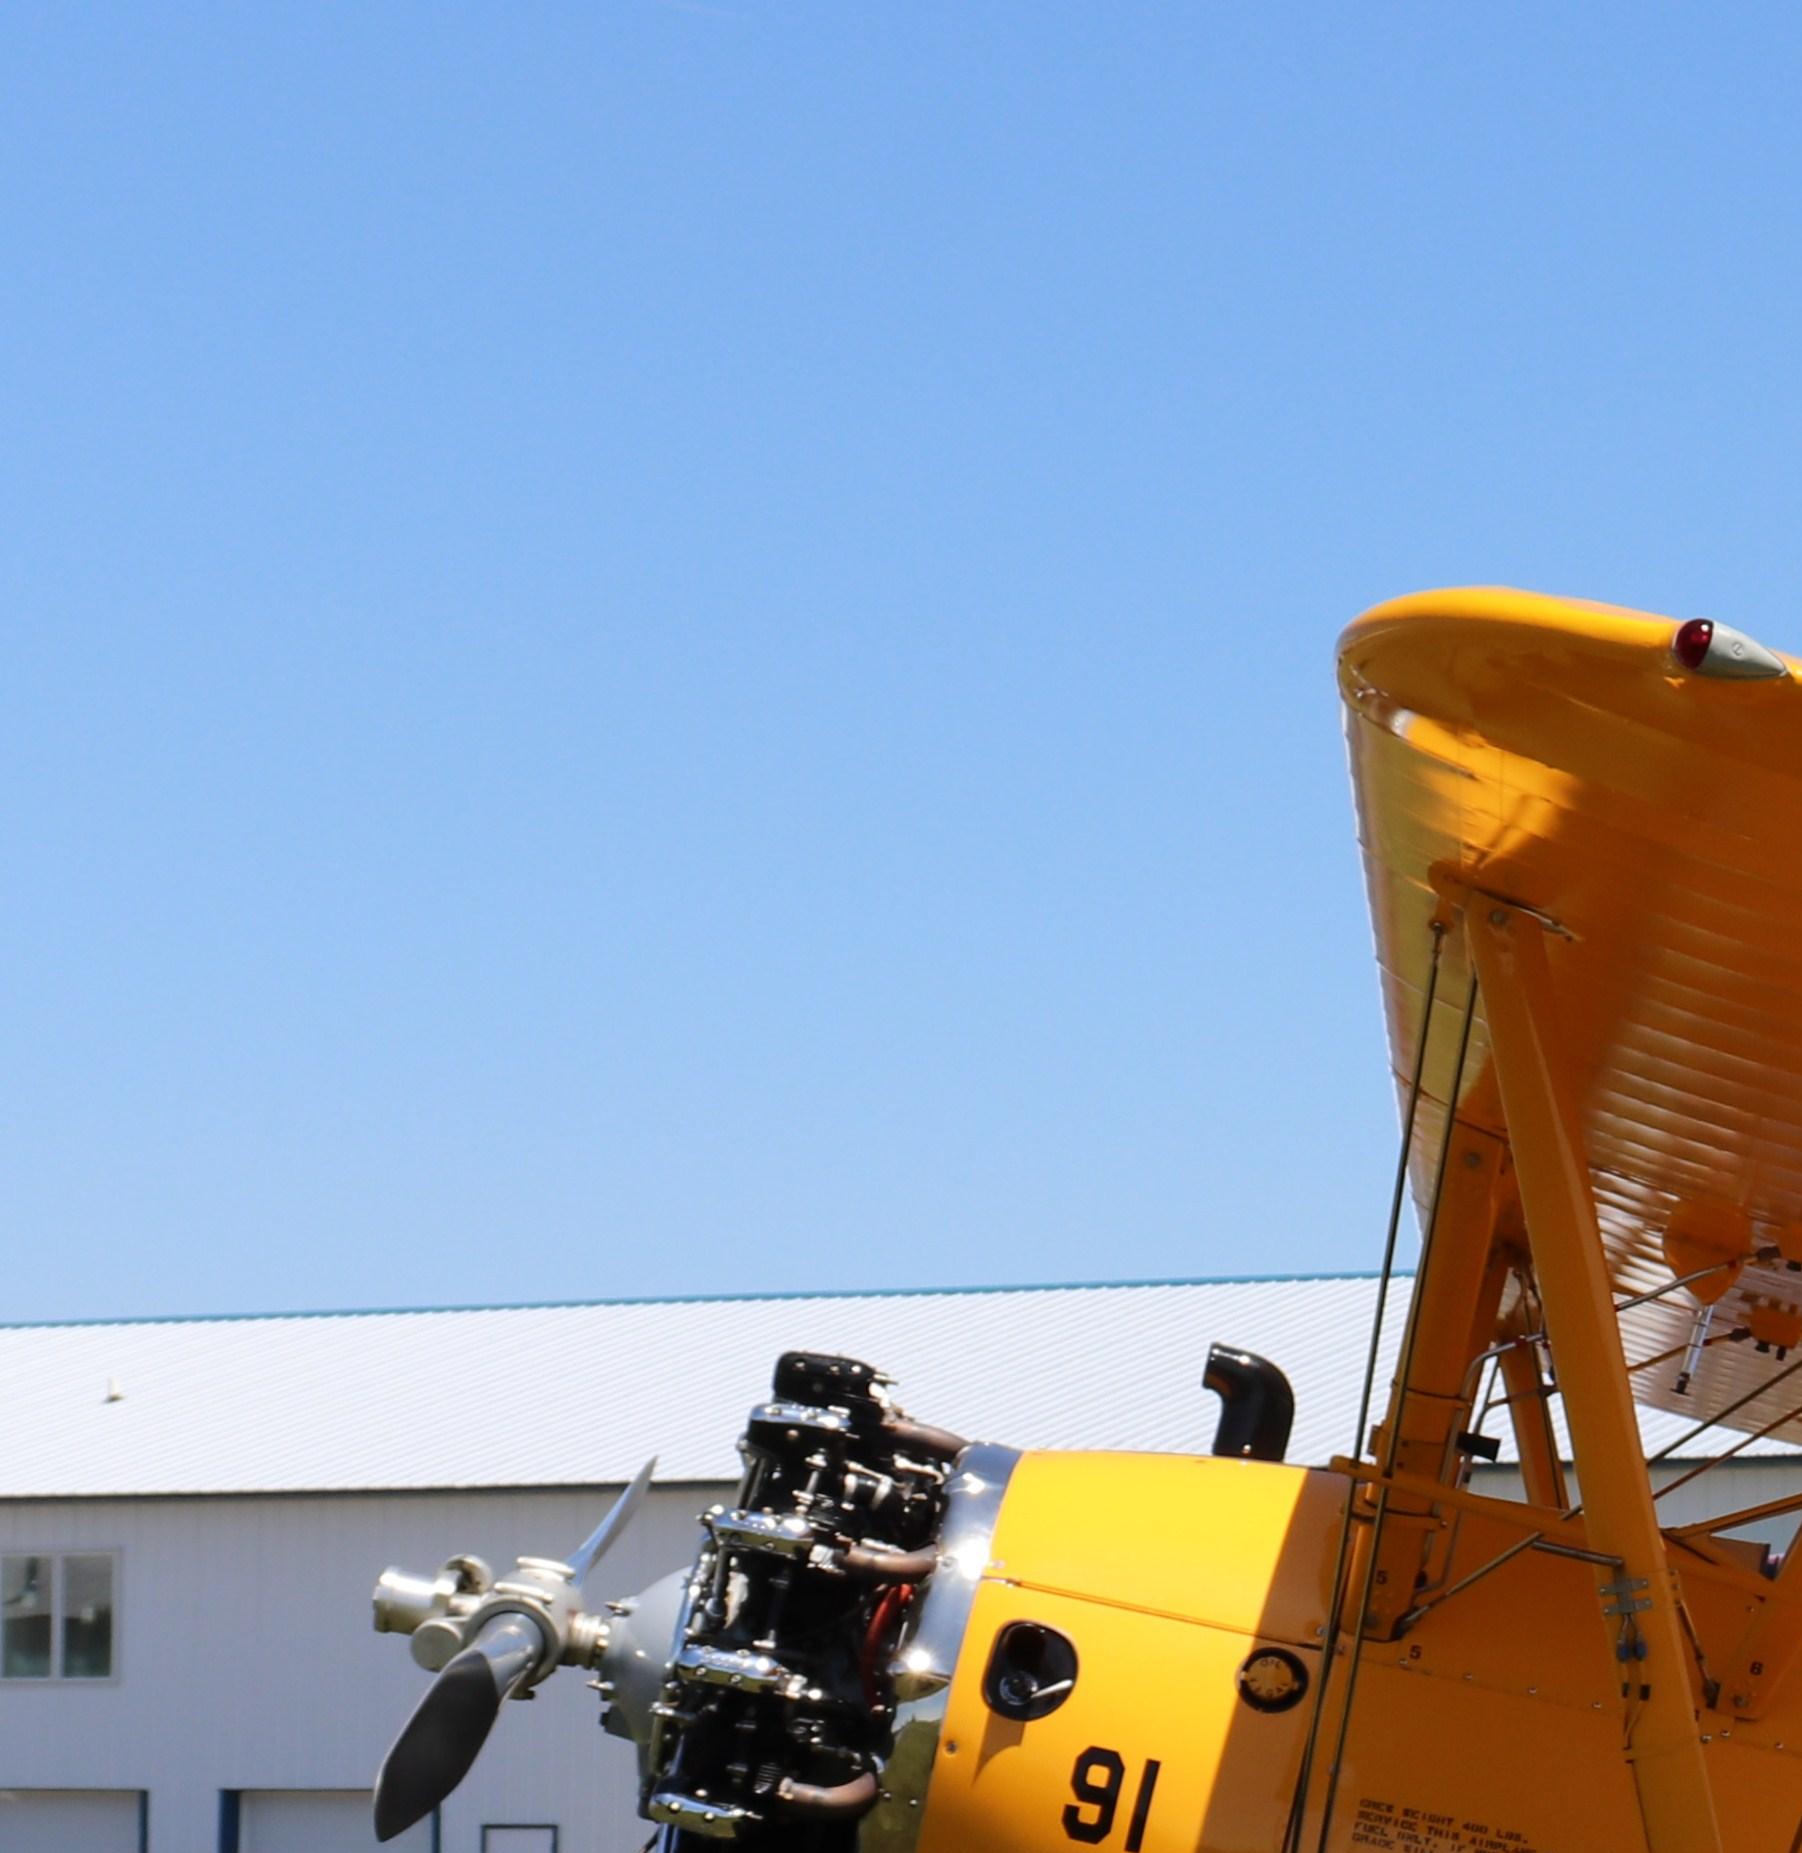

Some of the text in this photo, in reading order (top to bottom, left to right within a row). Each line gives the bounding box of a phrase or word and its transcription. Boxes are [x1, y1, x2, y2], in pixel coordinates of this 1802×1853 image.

[1409, 1645, 1422, 1660] 5
[1358, 1810, 1417, 1832] SERVICE
[1427, 1825, 1460, 1841] THIS
[1403, 1808, 1455, 1827] WEIGHT
[1355, 1821, 1389, 1838] FUEL
